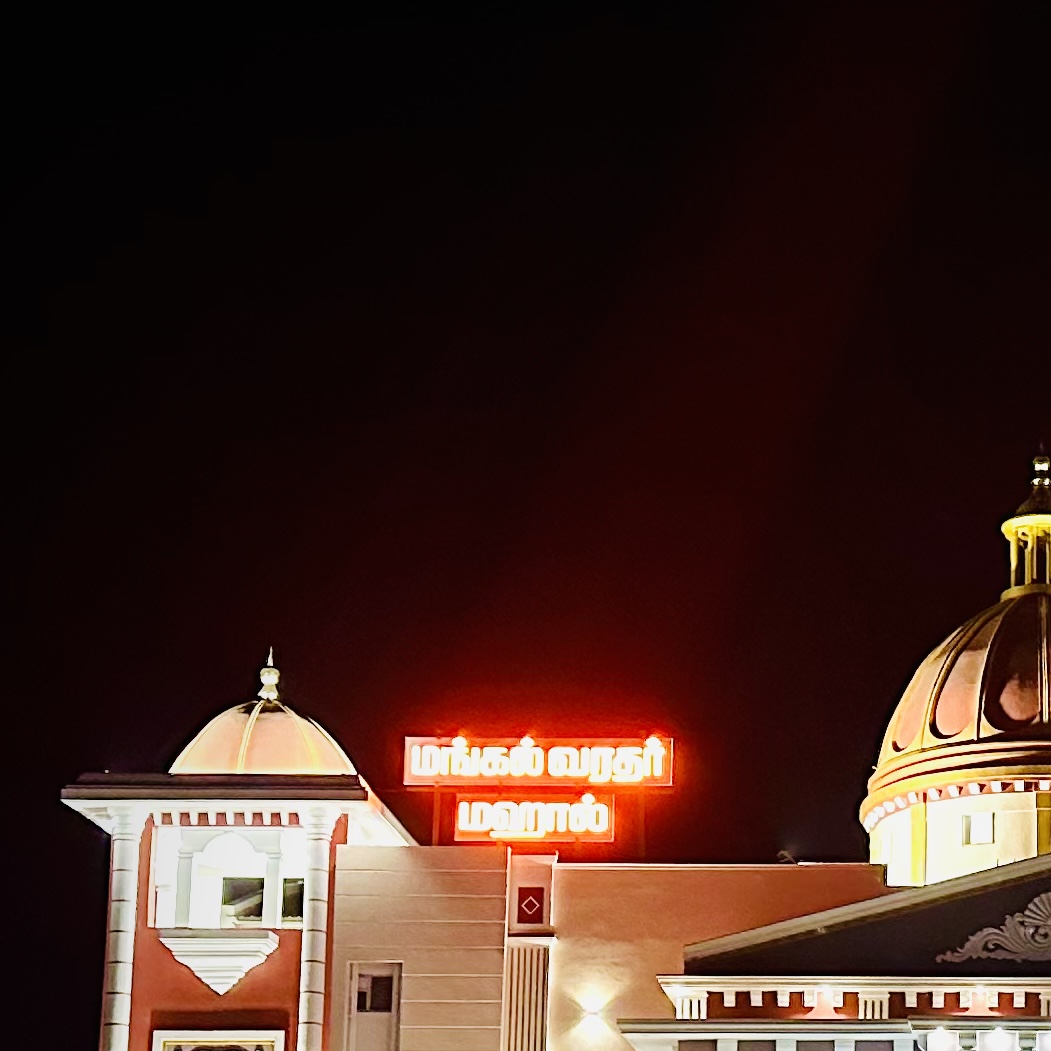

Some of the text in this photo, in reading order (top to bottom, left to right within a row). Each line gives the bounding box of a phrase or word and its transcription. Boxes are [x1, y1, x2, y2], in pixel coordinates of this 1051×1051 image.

[411, 735, 666, 783] மங்கல் வரதர்
[457, 793, 609, 838] மஹால்
